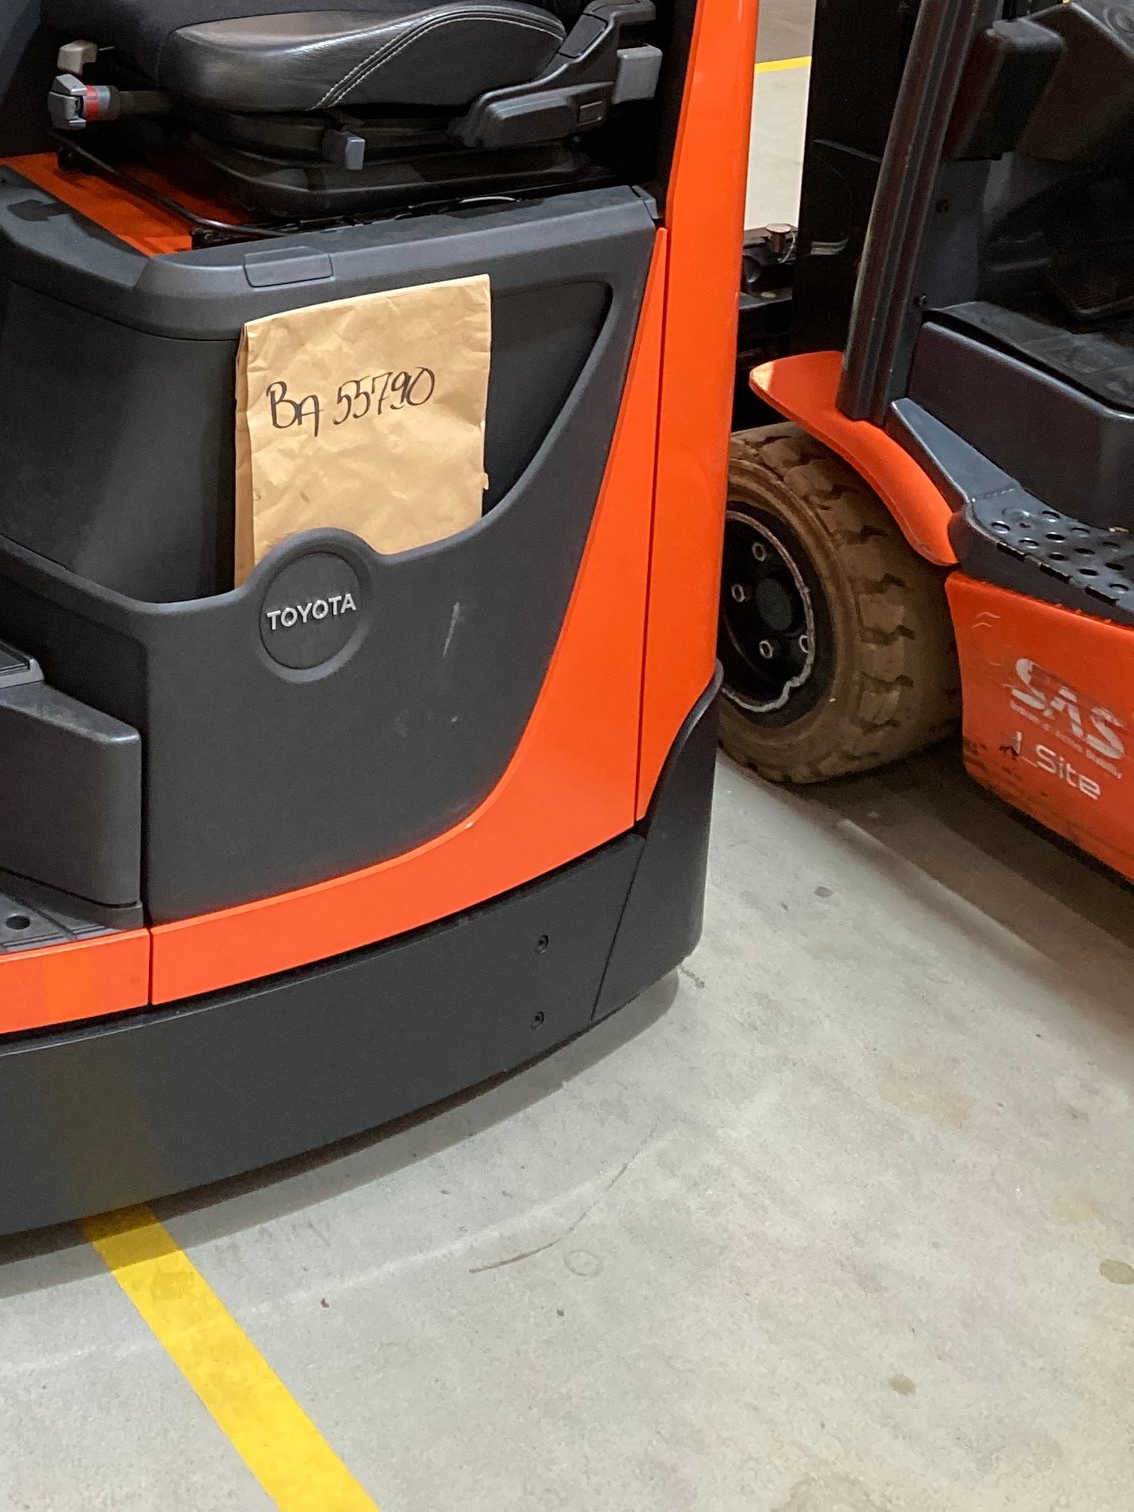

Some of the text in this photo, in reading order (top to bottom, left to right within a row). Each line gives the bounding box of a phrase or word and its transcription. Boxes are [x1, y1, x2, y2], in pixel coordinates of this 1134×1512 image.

[266, 366, 435, 437] BA 55790
[266, 592, 357, 631] TOYOTA
